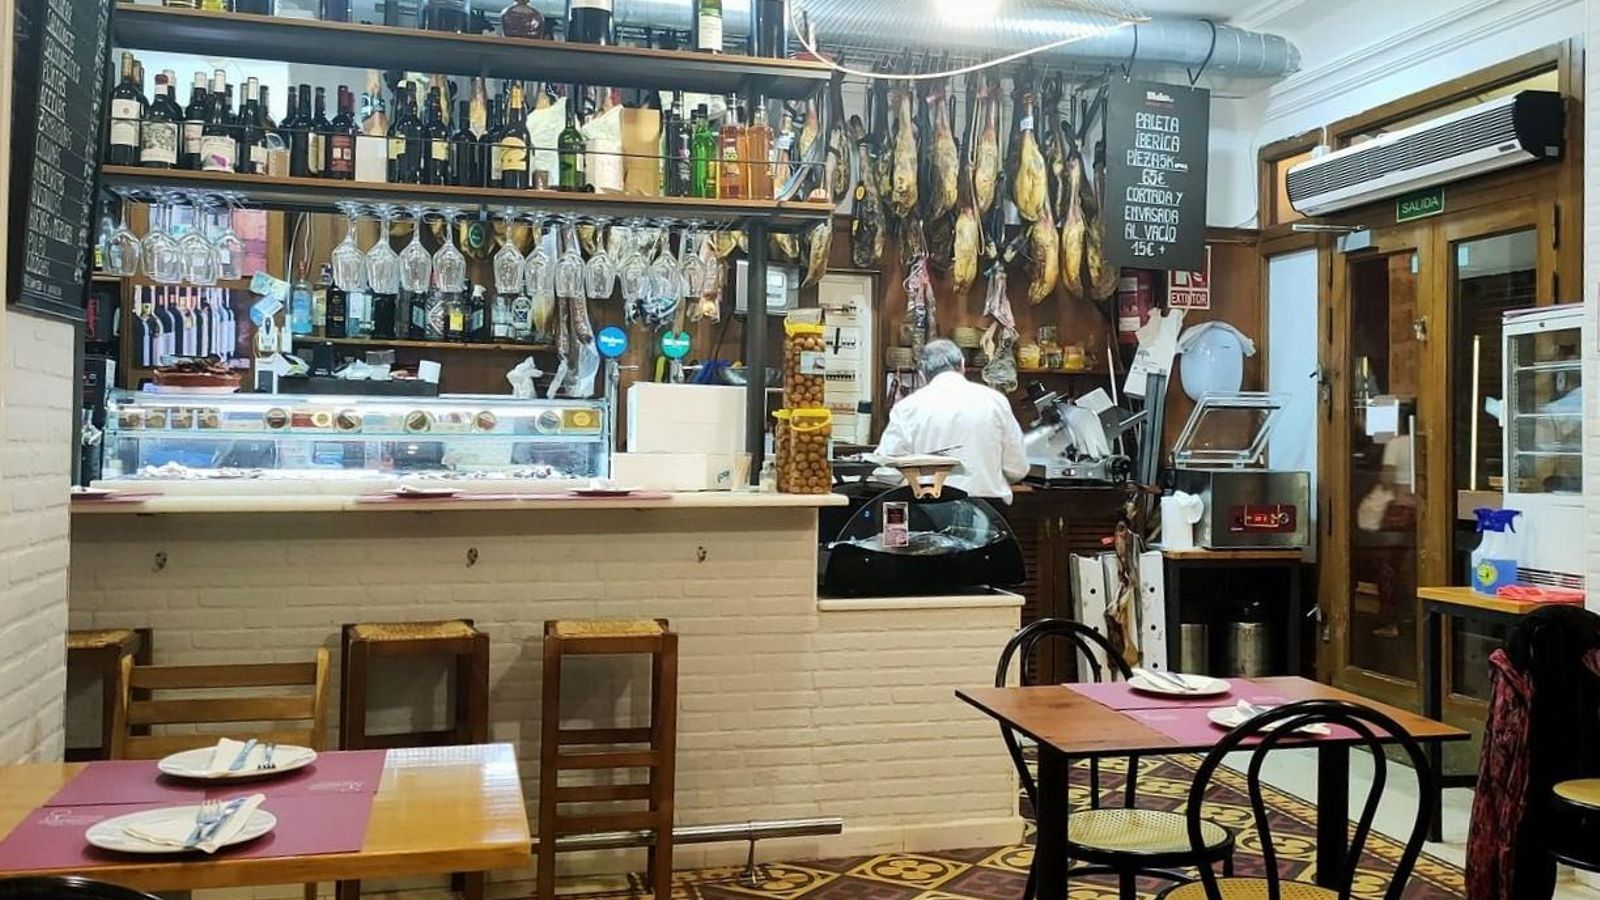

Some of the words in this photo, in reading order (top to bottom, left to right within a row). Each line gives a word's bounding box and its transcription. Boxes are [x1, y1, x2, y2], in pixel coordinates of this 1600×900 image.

[1135, 112, 1180, 133] PALETA
[1142, 168, 1166, 185] 65€
[1126, 186, 1173, 205] CORTADA
[1175, 192, 1184, 206] Y
[1401, 196, 1439, 214] SALIDA
[1124, 205, 1180, 225] ENVASADA
[1124, 222, 1138, 240] AL
[1130, 241, 1155, 257] 15€
[1171, 292, 1207, 305] EXTITOR
